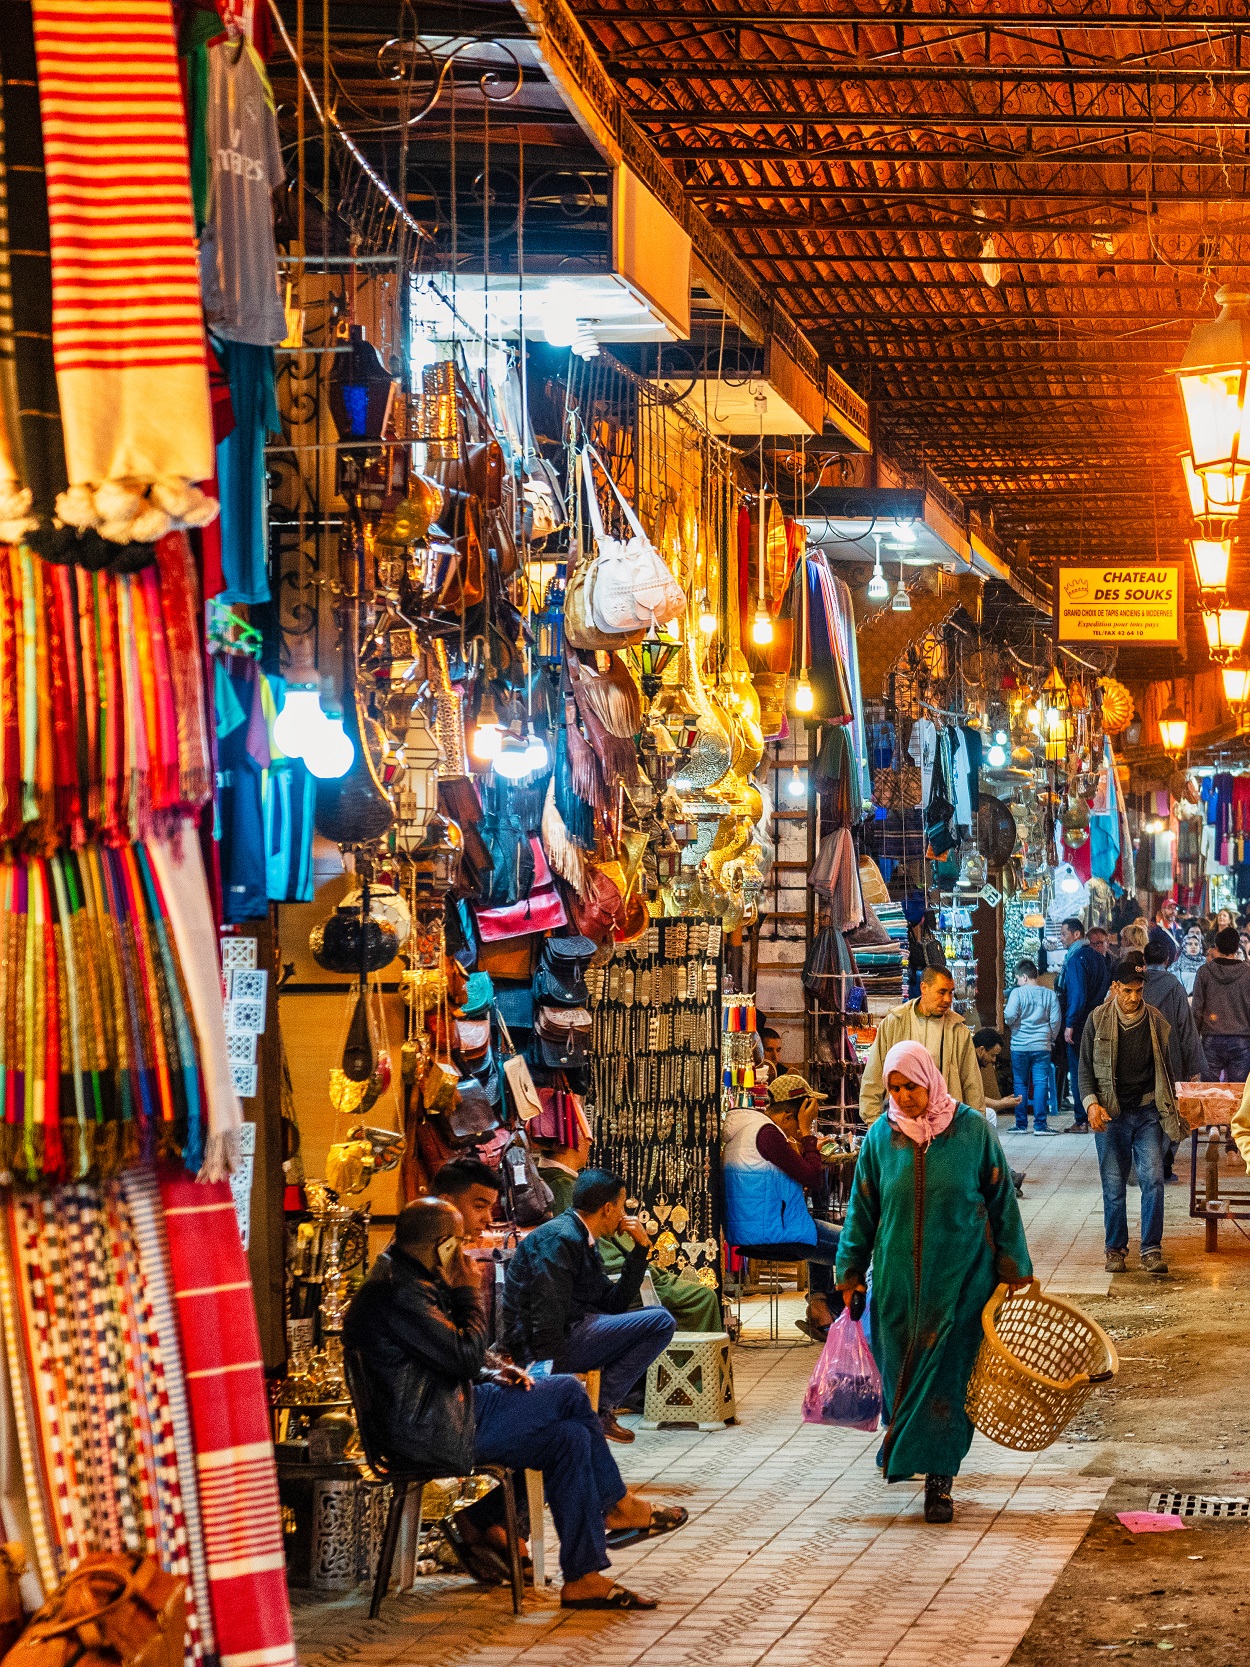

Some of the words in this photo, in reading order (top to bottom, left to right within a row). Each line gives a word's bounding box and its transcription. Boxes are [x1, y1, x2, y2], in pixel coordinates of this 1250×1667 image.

[1103, 572, 1168, 583] CHATEAU
[1094, 589, 1120, 600] DES
[1124, 589, 1173, 600] SOUKS
[1078, 620, 1112, 628] Expedition
